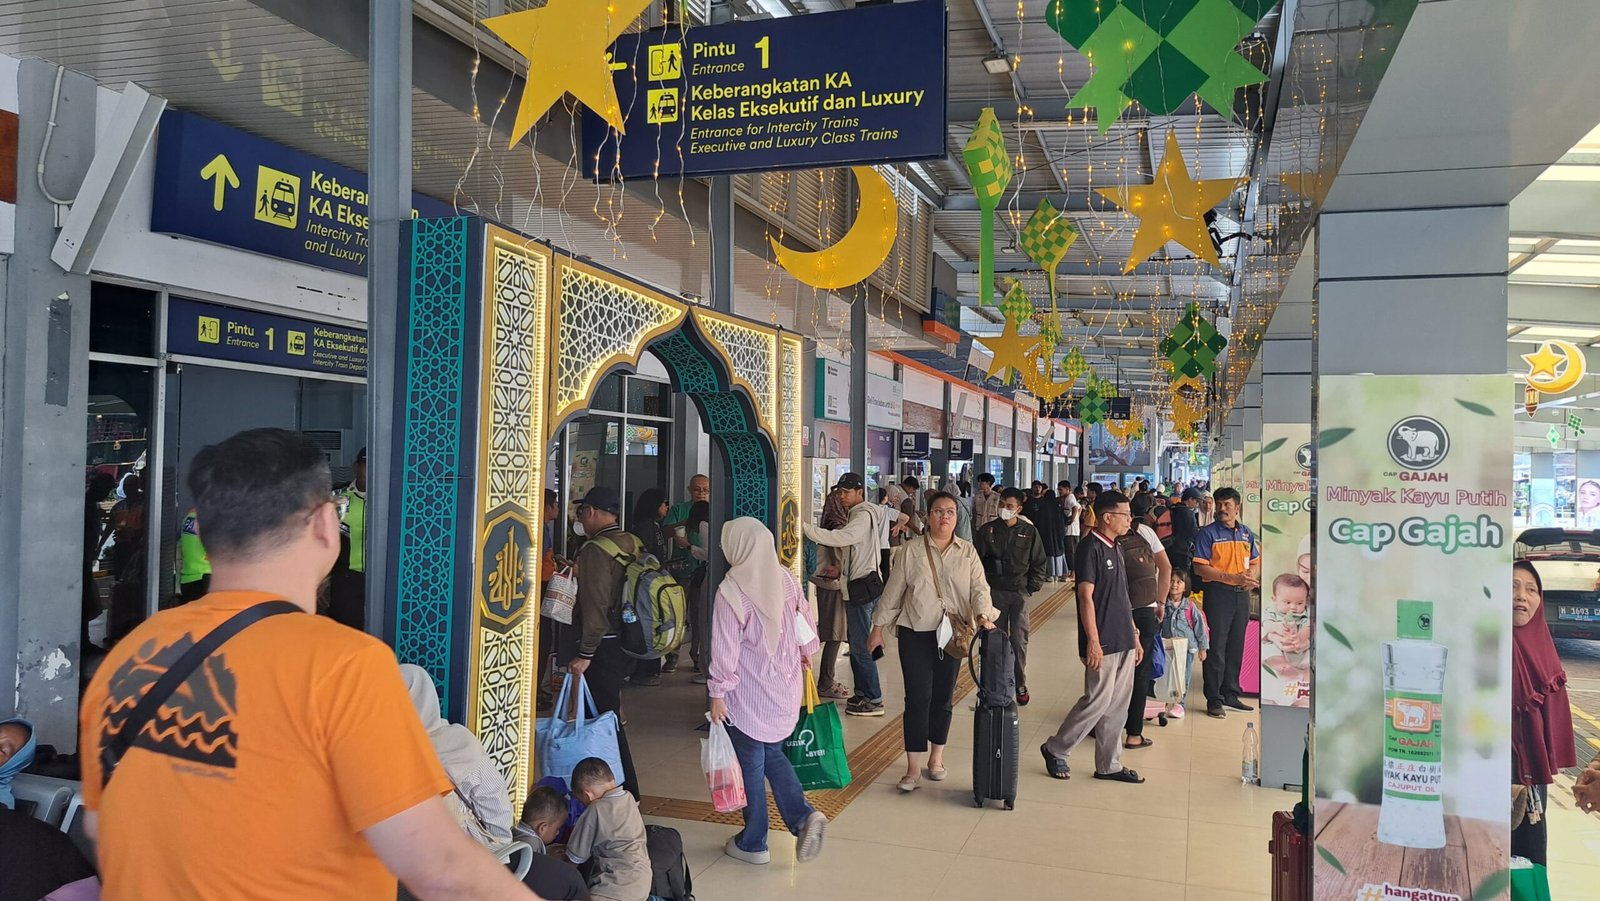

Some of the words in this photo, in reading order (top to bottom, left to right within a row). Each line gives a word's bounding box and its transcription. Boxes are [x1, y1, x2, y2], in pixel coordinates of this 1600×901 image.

[692, 42, 736, 59] Pintu
[754, 36, 770, 69] 1
[692, 61, 745, 76] Entrance
[691, 78, 820, 101] Keberangkatan
[825, 71, 852, 89] KA
[691, 103, 736, 121] Kelas
[740, 96, 819, 118] Eksekutif
[823, 95, 856, 111] dan
[861, 89, 925, 107] Luxury
[690, 126, 743, 140] Entrance
[746, 123, 764, 136] for
[767, 118, 818, 134] Intercity
[822, 115, 860, 130] Trains
[690, 141, 746, 154] Executive
[750, 137, 773, 150] and
[776, 133, 818, 149] Luxury
[821, 131, 855, 145] Class
[860, 127, 899, 141] Trains
[308, 195, 333, 220] KA
[306, 219, 352, 245] Intercity
[304, 239, 328, 254] and
[329, 243, 366, 265] Luxury
[226, 336, 260, 349] Entrance
[227, 321, 255, 336] Pintu
[265, 327, 275, 351] 1
[313, 326, 367, 344] Keberangkatan
[313, 338, 326, 349] KA
[326, 340, 359, 353] Eksekutif
[1399, 472, 1448, 483] GAJAH
[1267, 498, 1300, 516] Cap
[1326, 486, 1396, 506] Minyak
[1401, 488, 1449, 508] Kayu
[1456, 489, 1507, 507] Putih
[1328, 517, 1396, 553] Cap
[1399, 514, 1503, 555] Gajah
[1387, 781, 1423, 791] CAJUPUT
[1424, 784, 1436, 793] OIL
[1403, 773, 1428, 784] KAYU
